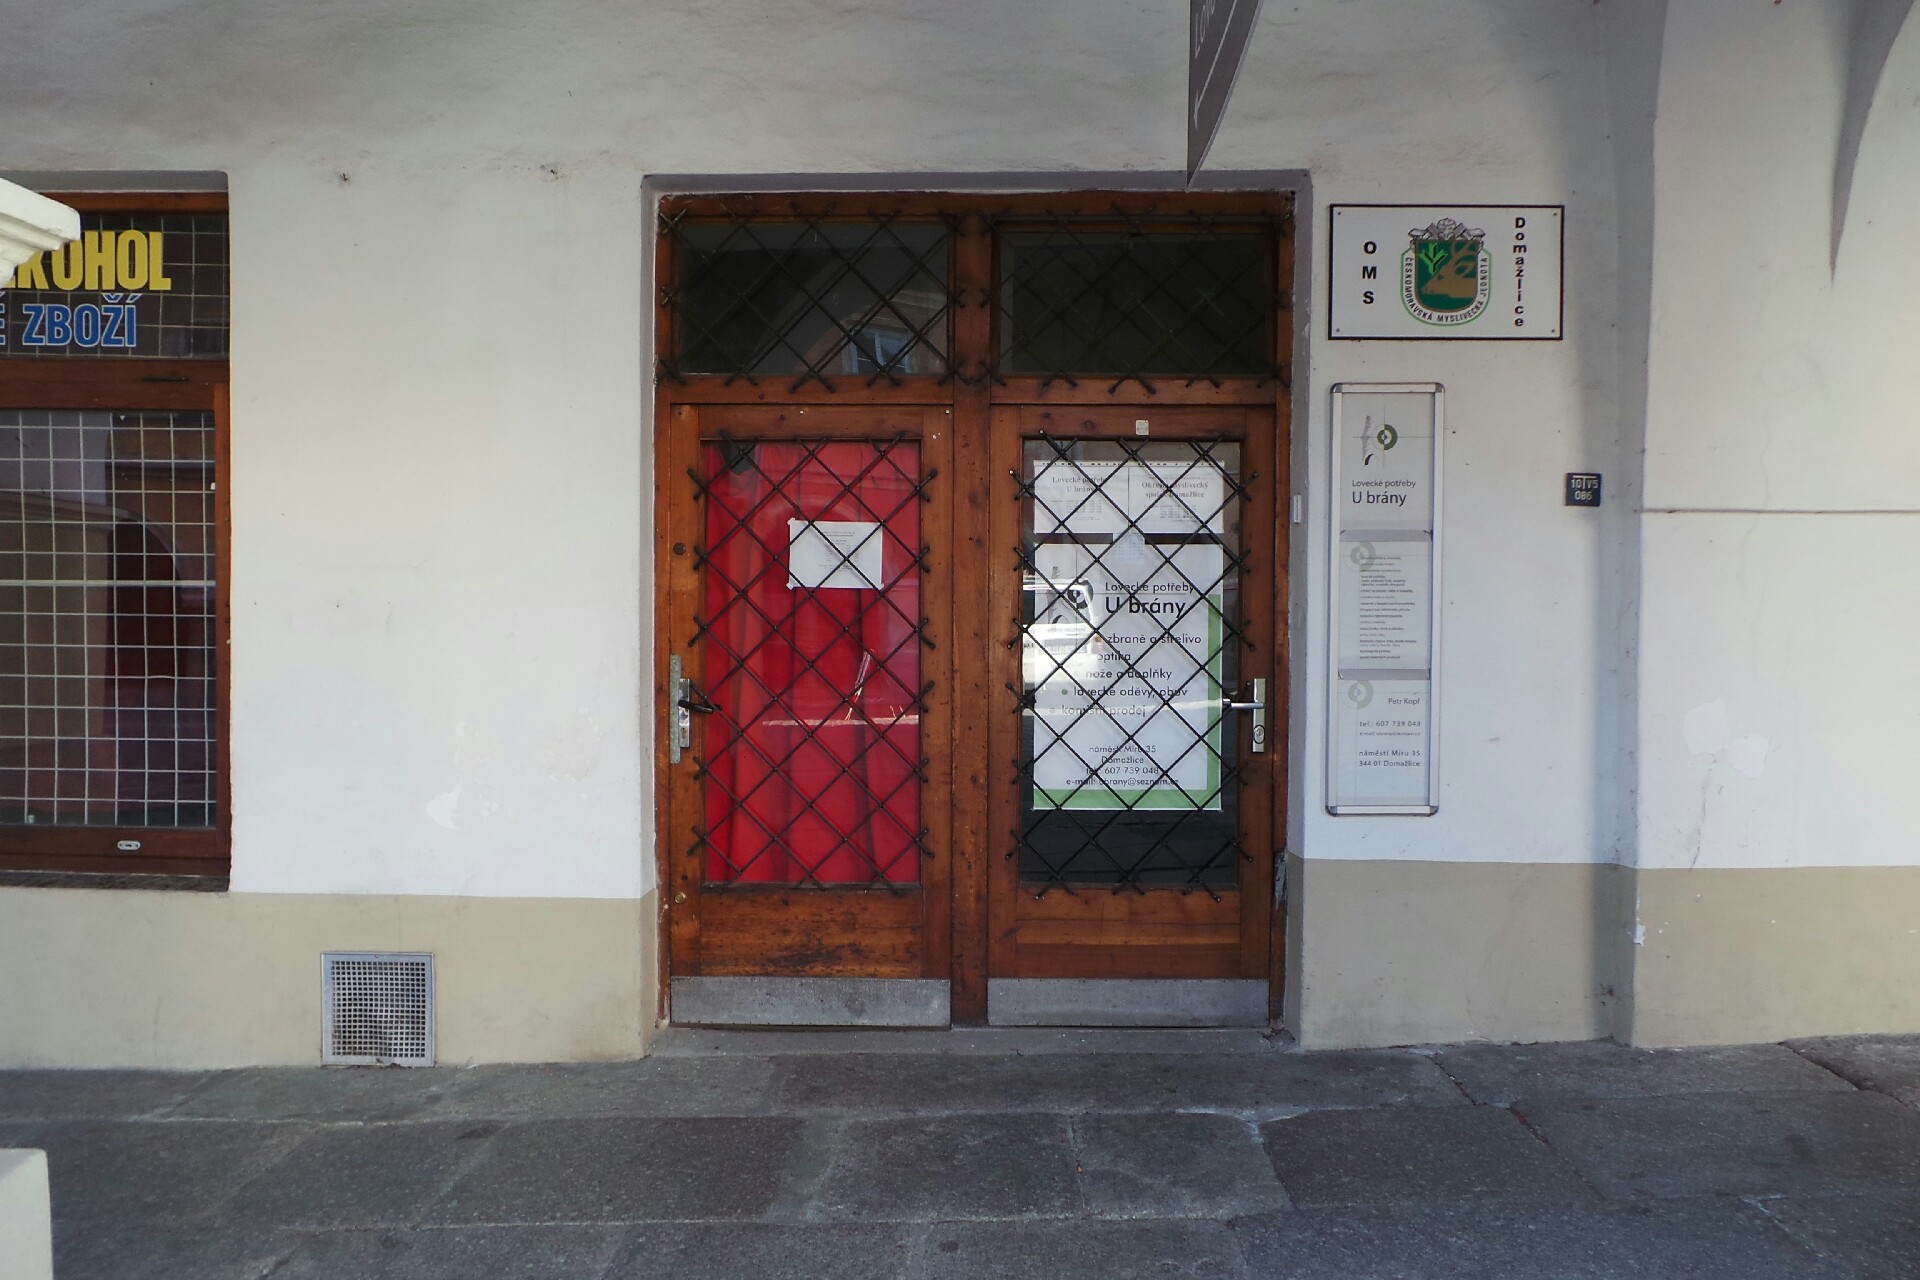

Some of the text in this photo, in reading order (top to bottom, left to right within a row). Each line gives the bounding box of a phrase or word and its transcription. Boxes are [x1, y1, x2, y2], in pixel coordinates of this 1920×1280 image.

[3, 229, 172, 290] KOHOL
[1362, 240, 1377, 305] OMS
[1480, 257, 1488, 299] JEDNOTA
[1512, 216, 1527, 327] Domažlice
[22, 292, 143, 347] ZBOŽÍ
[1385, 480, 1416, 489] potřeby
[1352, 491, 1407, 507] U brány
[1105, 597, 1187, 620] U brány
[1108, 633, 1146, 644] zbraně
[1085, 668, 1112, 679] nože
[1127, 668, 1173, 681] doplňky
[1074, 686, 1116, 696] lovecké
[1146, 745, 1156, 753] 35
[1104, 767, 1121, 775] 607
[1124, 767, 1140, 775] 739
[1143, 767, 1159, 775] 048
